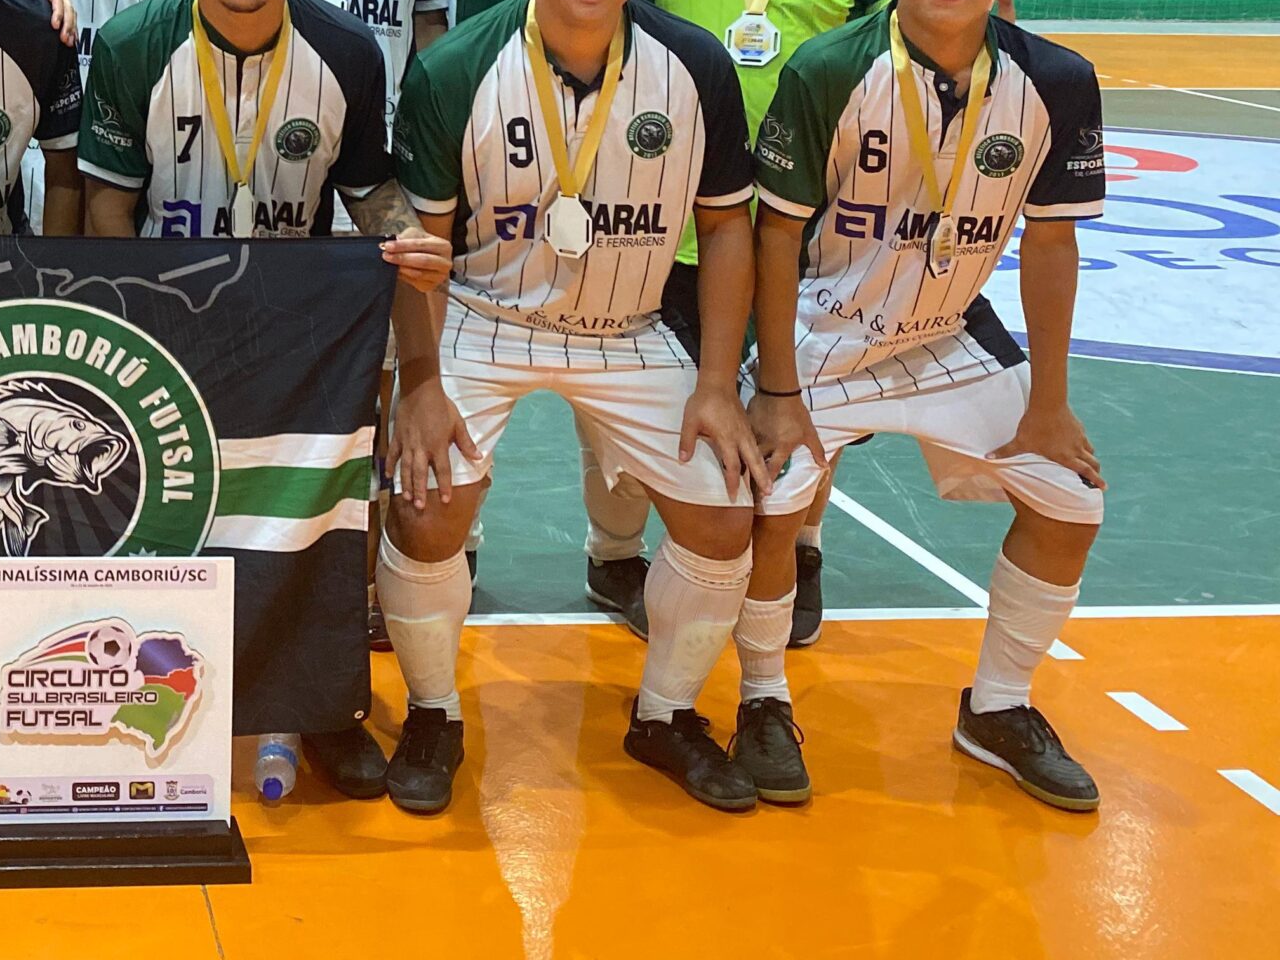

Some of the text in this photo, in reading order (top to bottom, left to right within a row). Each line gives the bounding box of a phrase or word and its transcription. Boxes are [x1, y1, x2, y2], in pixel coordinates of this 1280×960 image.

[176, 115, 202, 164] 7
[506, 116, 534, 168] 9
[858, 129, 888, 173] 6
[596, 236, 666, 248] E FERRAGENS
[816, 288, 864, 324] G.R.A
[870, 314, 886, 335] &
[138, 386, 194, 504] FUTSAL
[94, 565, 207, 583] CAMBORIÚ/SC
[8, 669, 128, 687] CIRCUITO
[7, 691, 158, 704] SULBRASILEIRO
[7, 710, 103, 727] FUTSAL
[76, 785, 117, 794] CAMPEÃO
